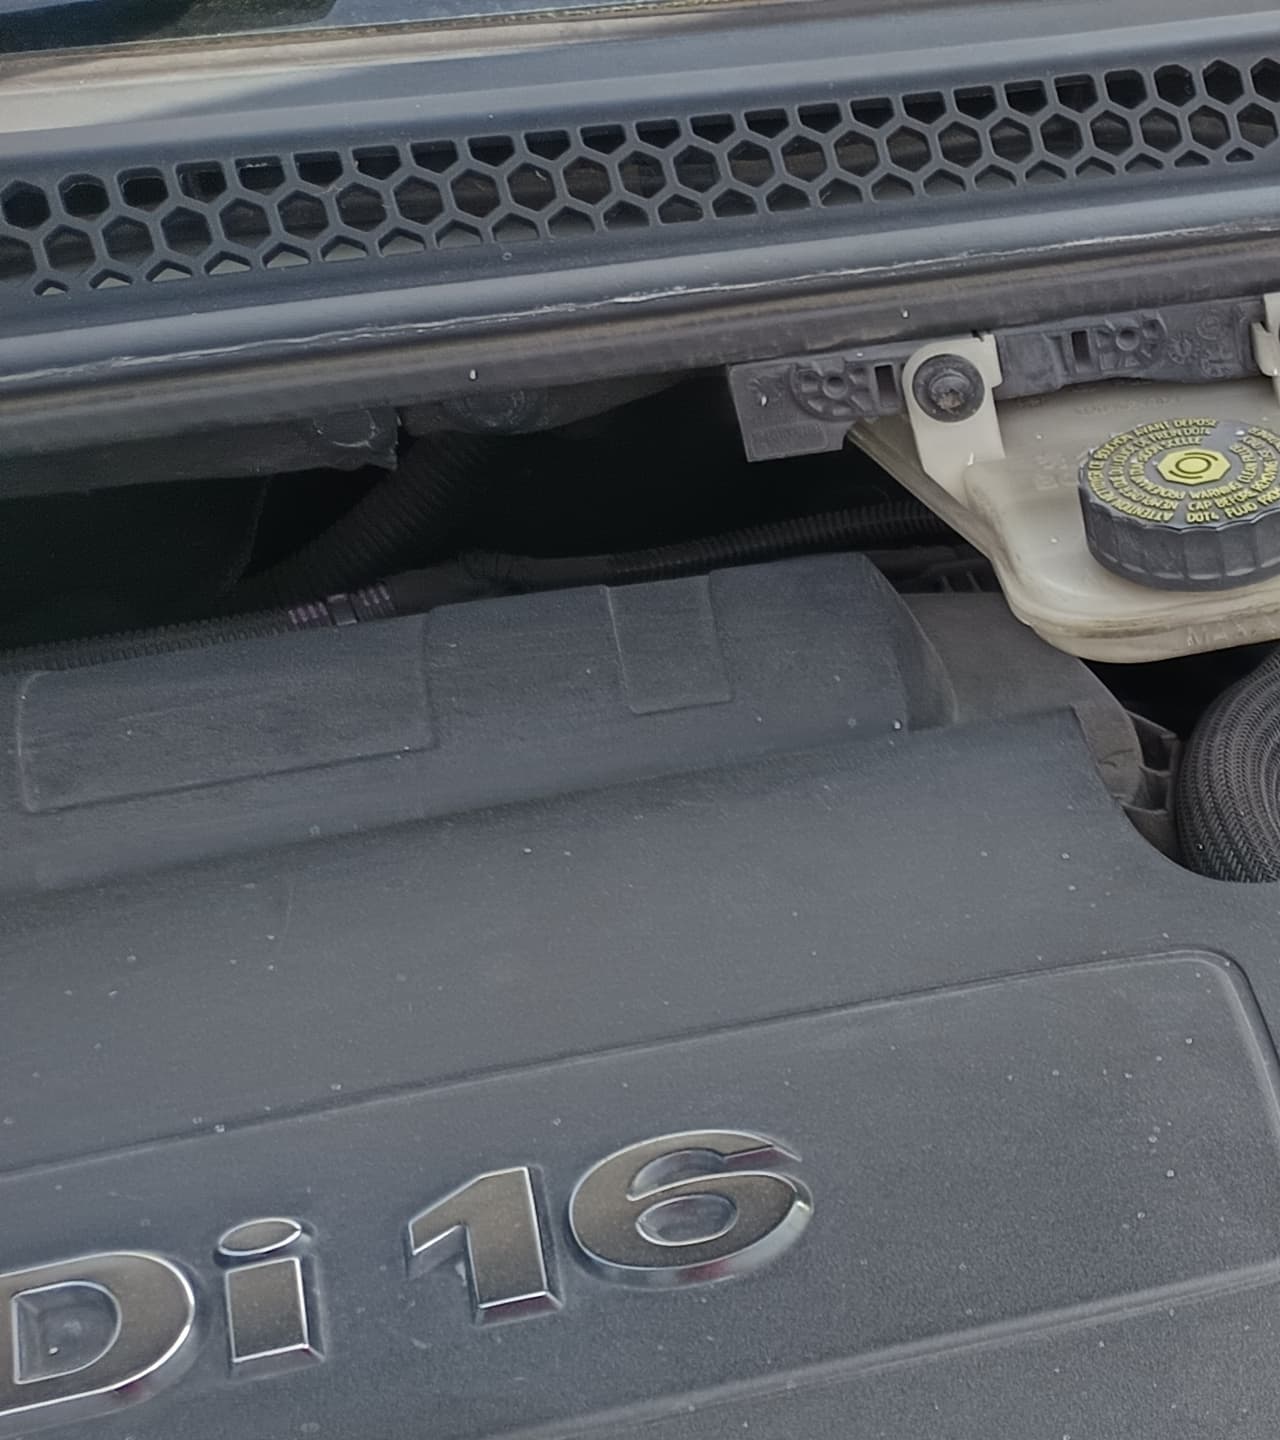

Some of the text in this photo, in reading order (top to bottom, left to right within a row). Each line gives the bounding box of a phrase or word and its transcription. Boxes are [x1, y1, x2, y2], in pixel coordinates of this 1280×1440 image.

[1134, 422, 1170, 435] AVANT
[1188, 500, 1212, 511] CAP
[1216, 489, 1258, 507] BEFORE
[1189, 482, 1242, 498] WARNING
[1111, 499, 1174, 521] ATTENTION
[1186, 513, 1219, 522] DOT4
[1224, 503, 1257, 517] FLUID
[407, 1129, 814, 1326] 16
